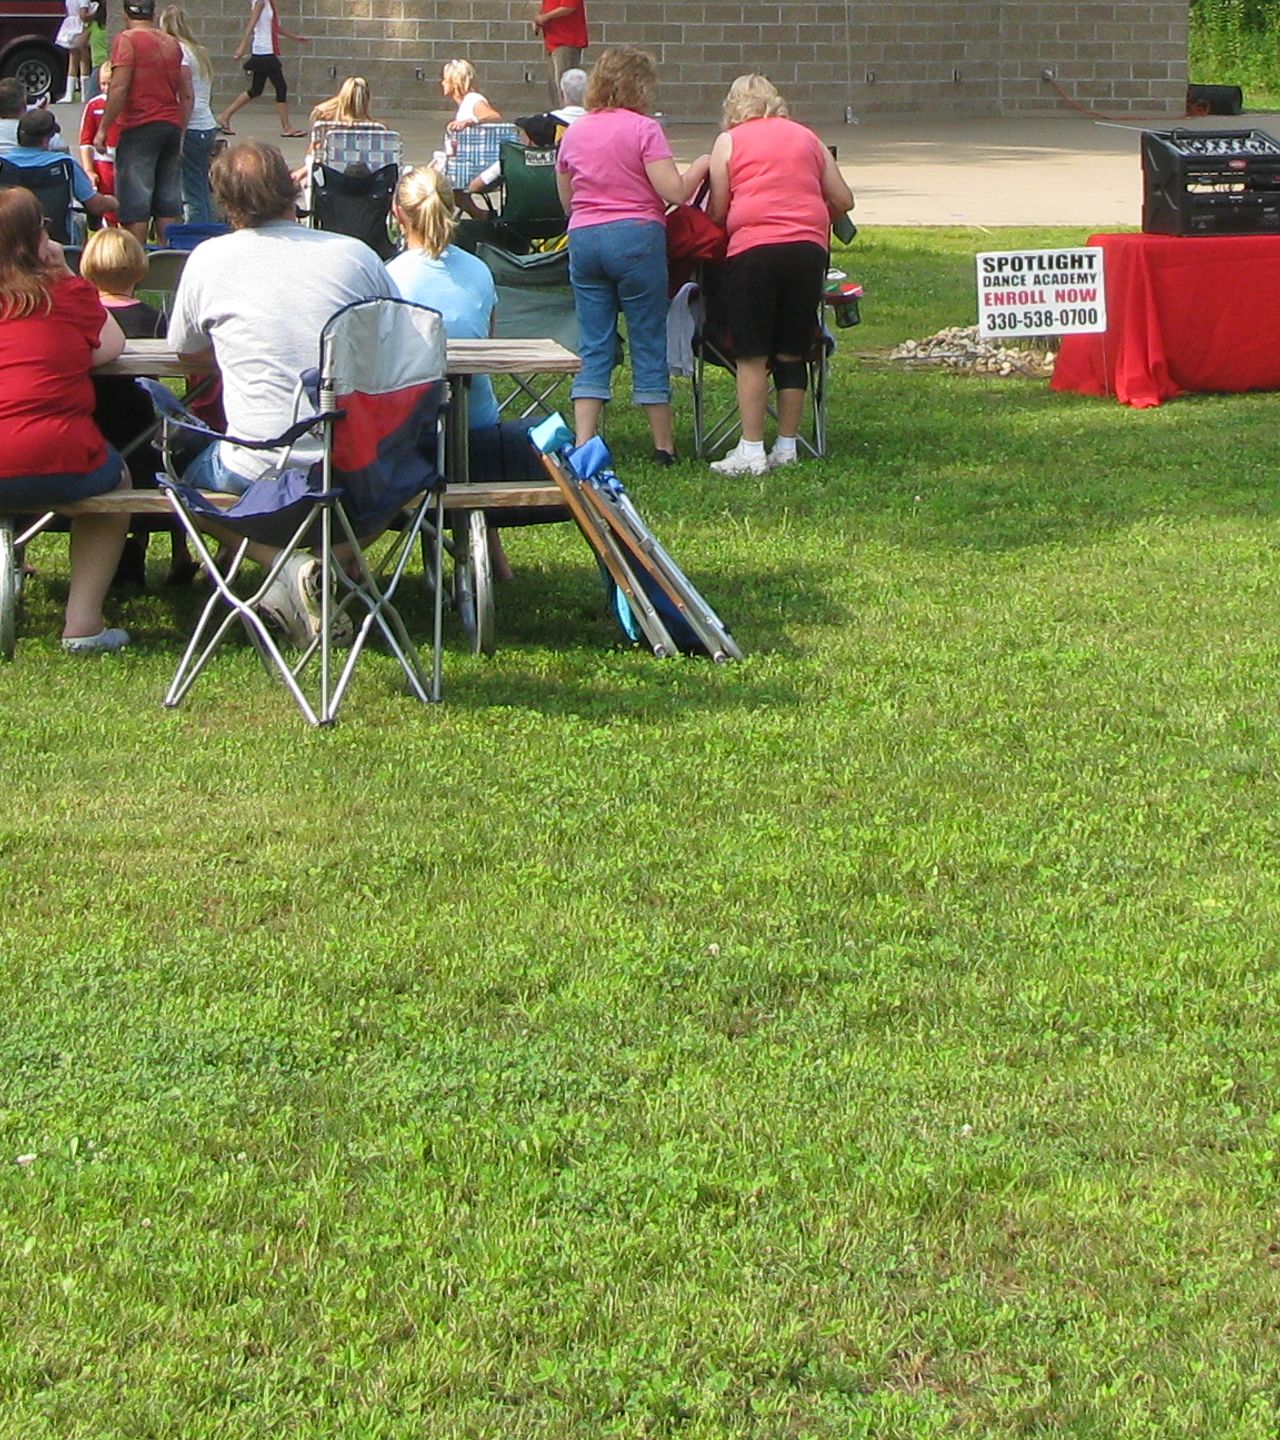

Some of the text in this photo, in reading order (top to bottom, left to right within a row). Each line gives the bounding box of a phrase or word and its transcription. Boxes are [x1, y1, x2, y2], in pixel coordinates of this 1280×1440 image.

[982, 254, 1097, 273] SPOTLIGHT
[983, 273, 1097, 287] DANCE ACADEMY
[984, 288, 1097, 307] ENROLL NOW
[986, 308, 1098, 331] 330-538-0700
